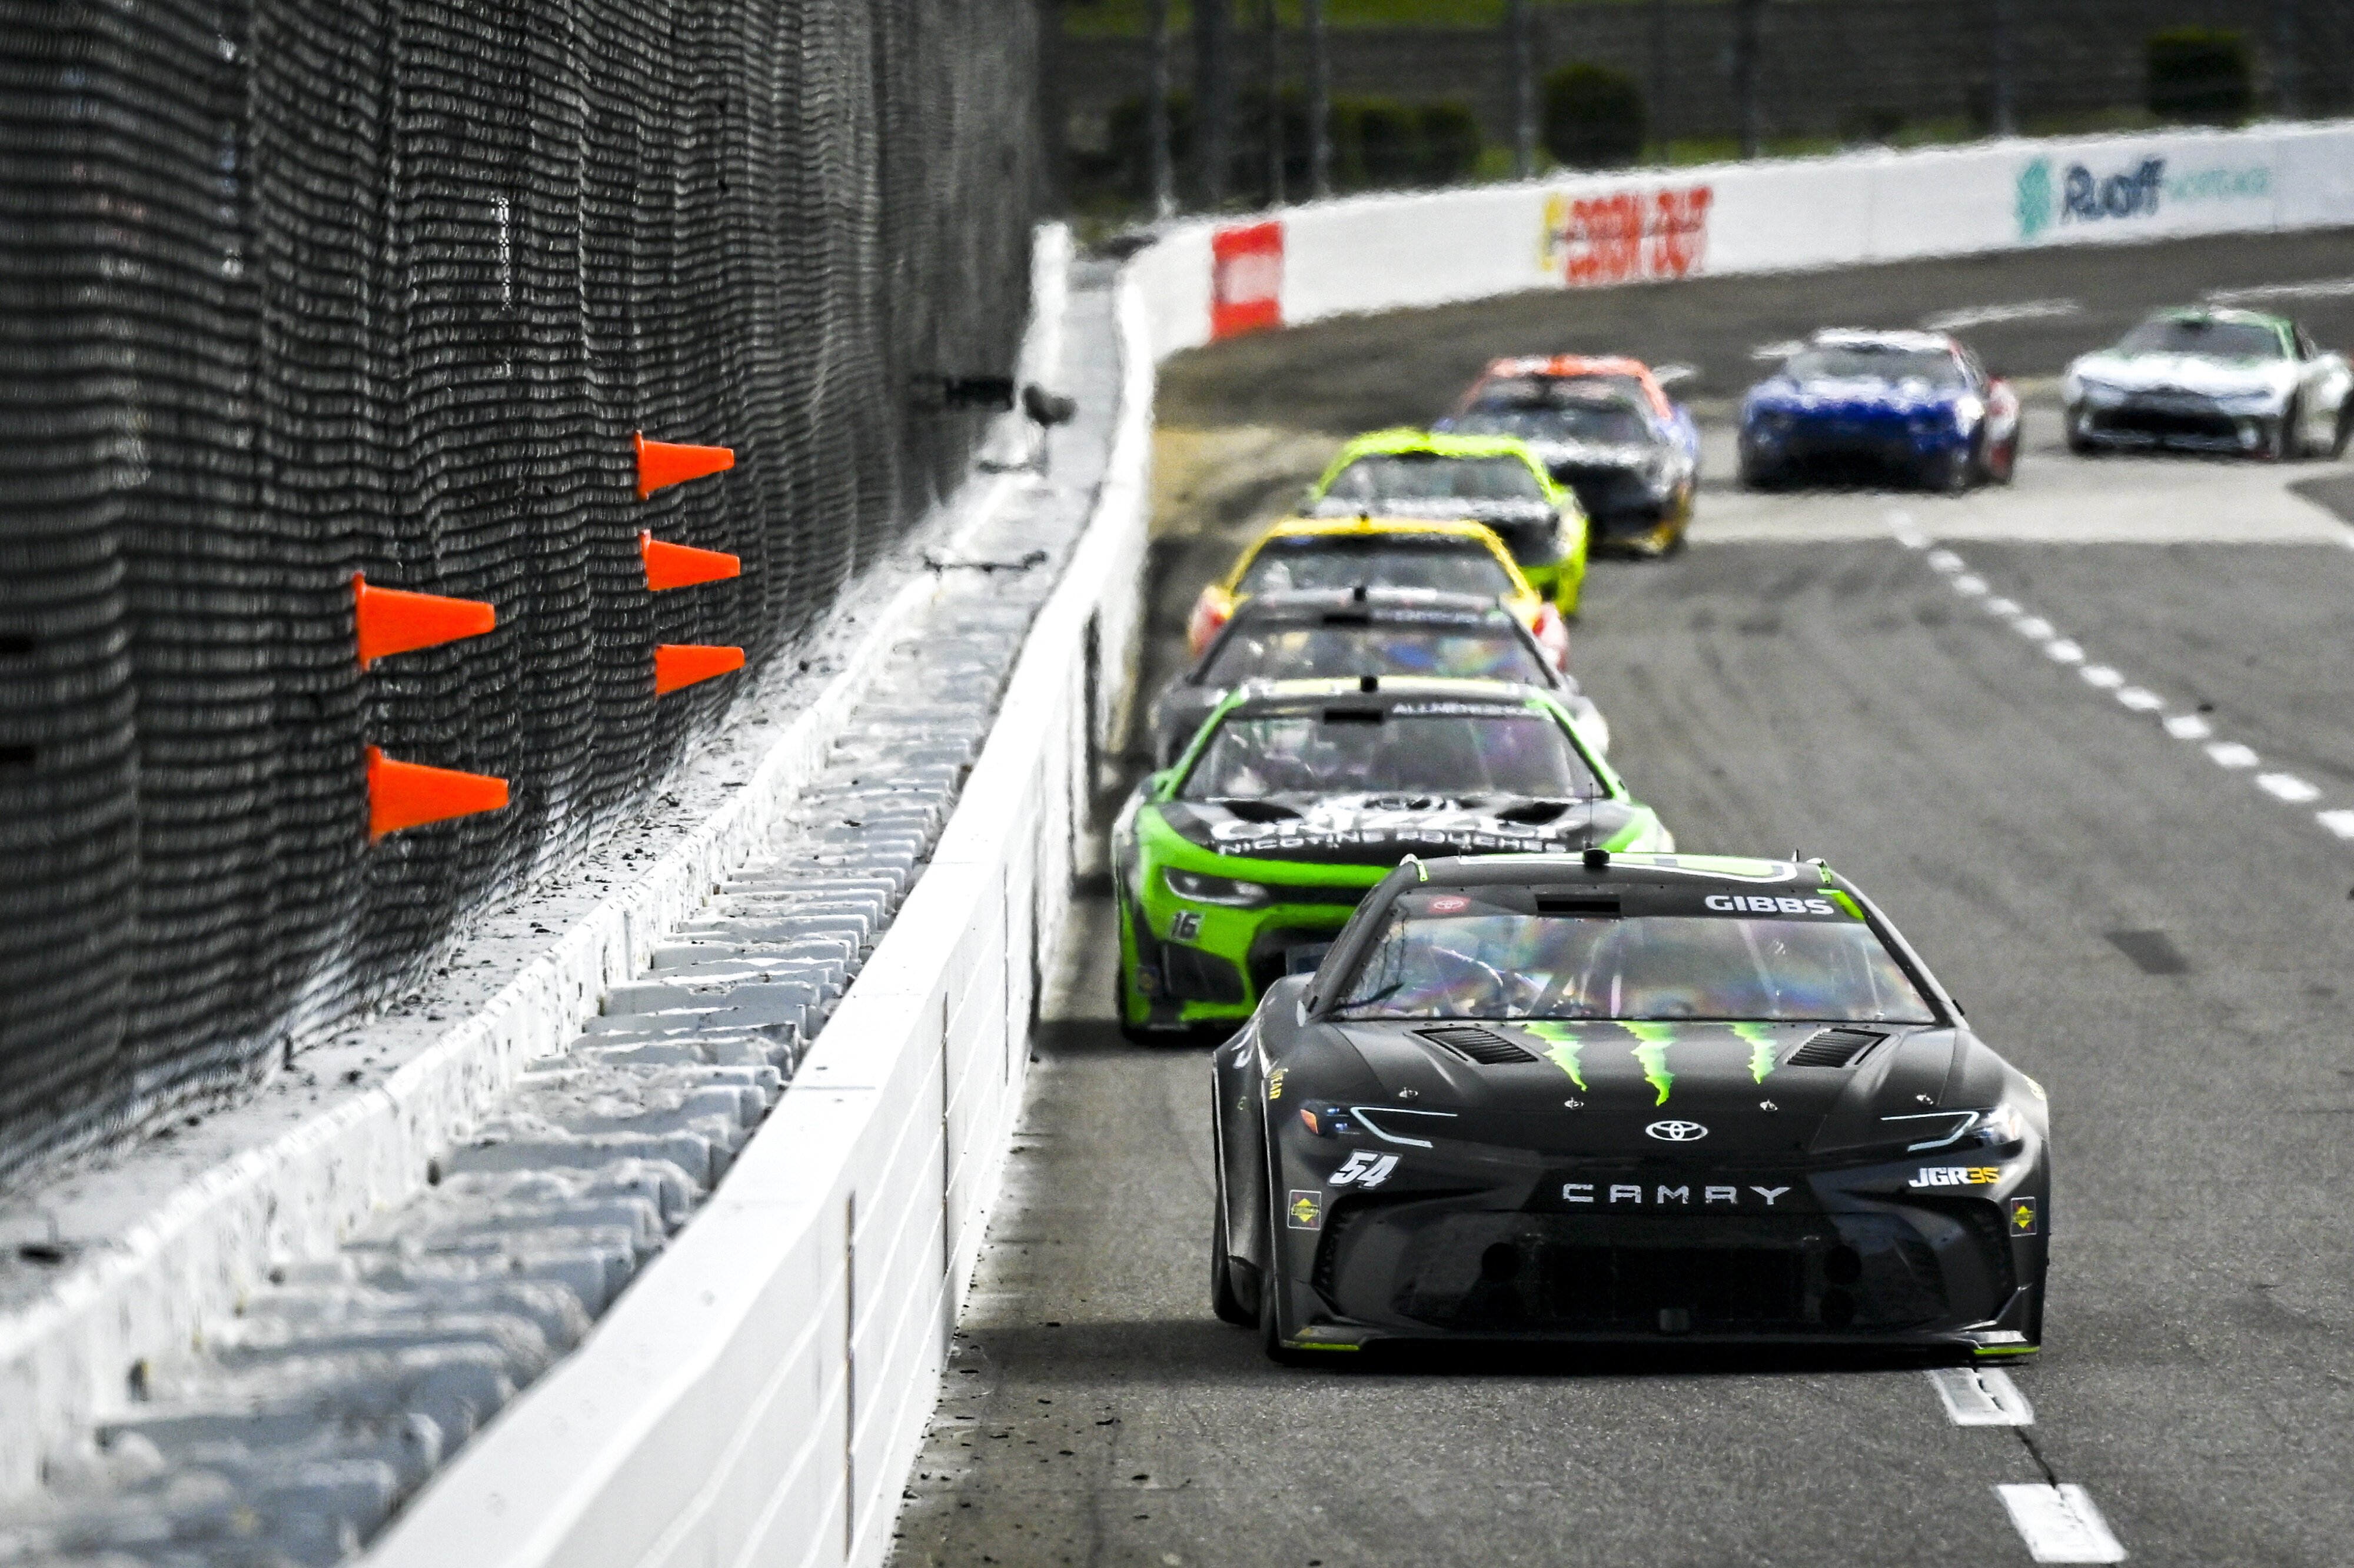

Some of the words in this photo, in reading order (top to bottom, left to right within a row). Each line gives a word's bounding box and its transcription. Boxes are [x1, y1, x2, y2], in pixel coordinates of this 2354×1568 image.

[1705, 895, 1834, 915] GIBBS
[1172, 910, 1203, 940] 16
[1328, 1150, 1401, 1187] 54
[1908, 1167, 2002, 1188] JGR35
[1562, 1183, 1792, 1205] CAMRY
